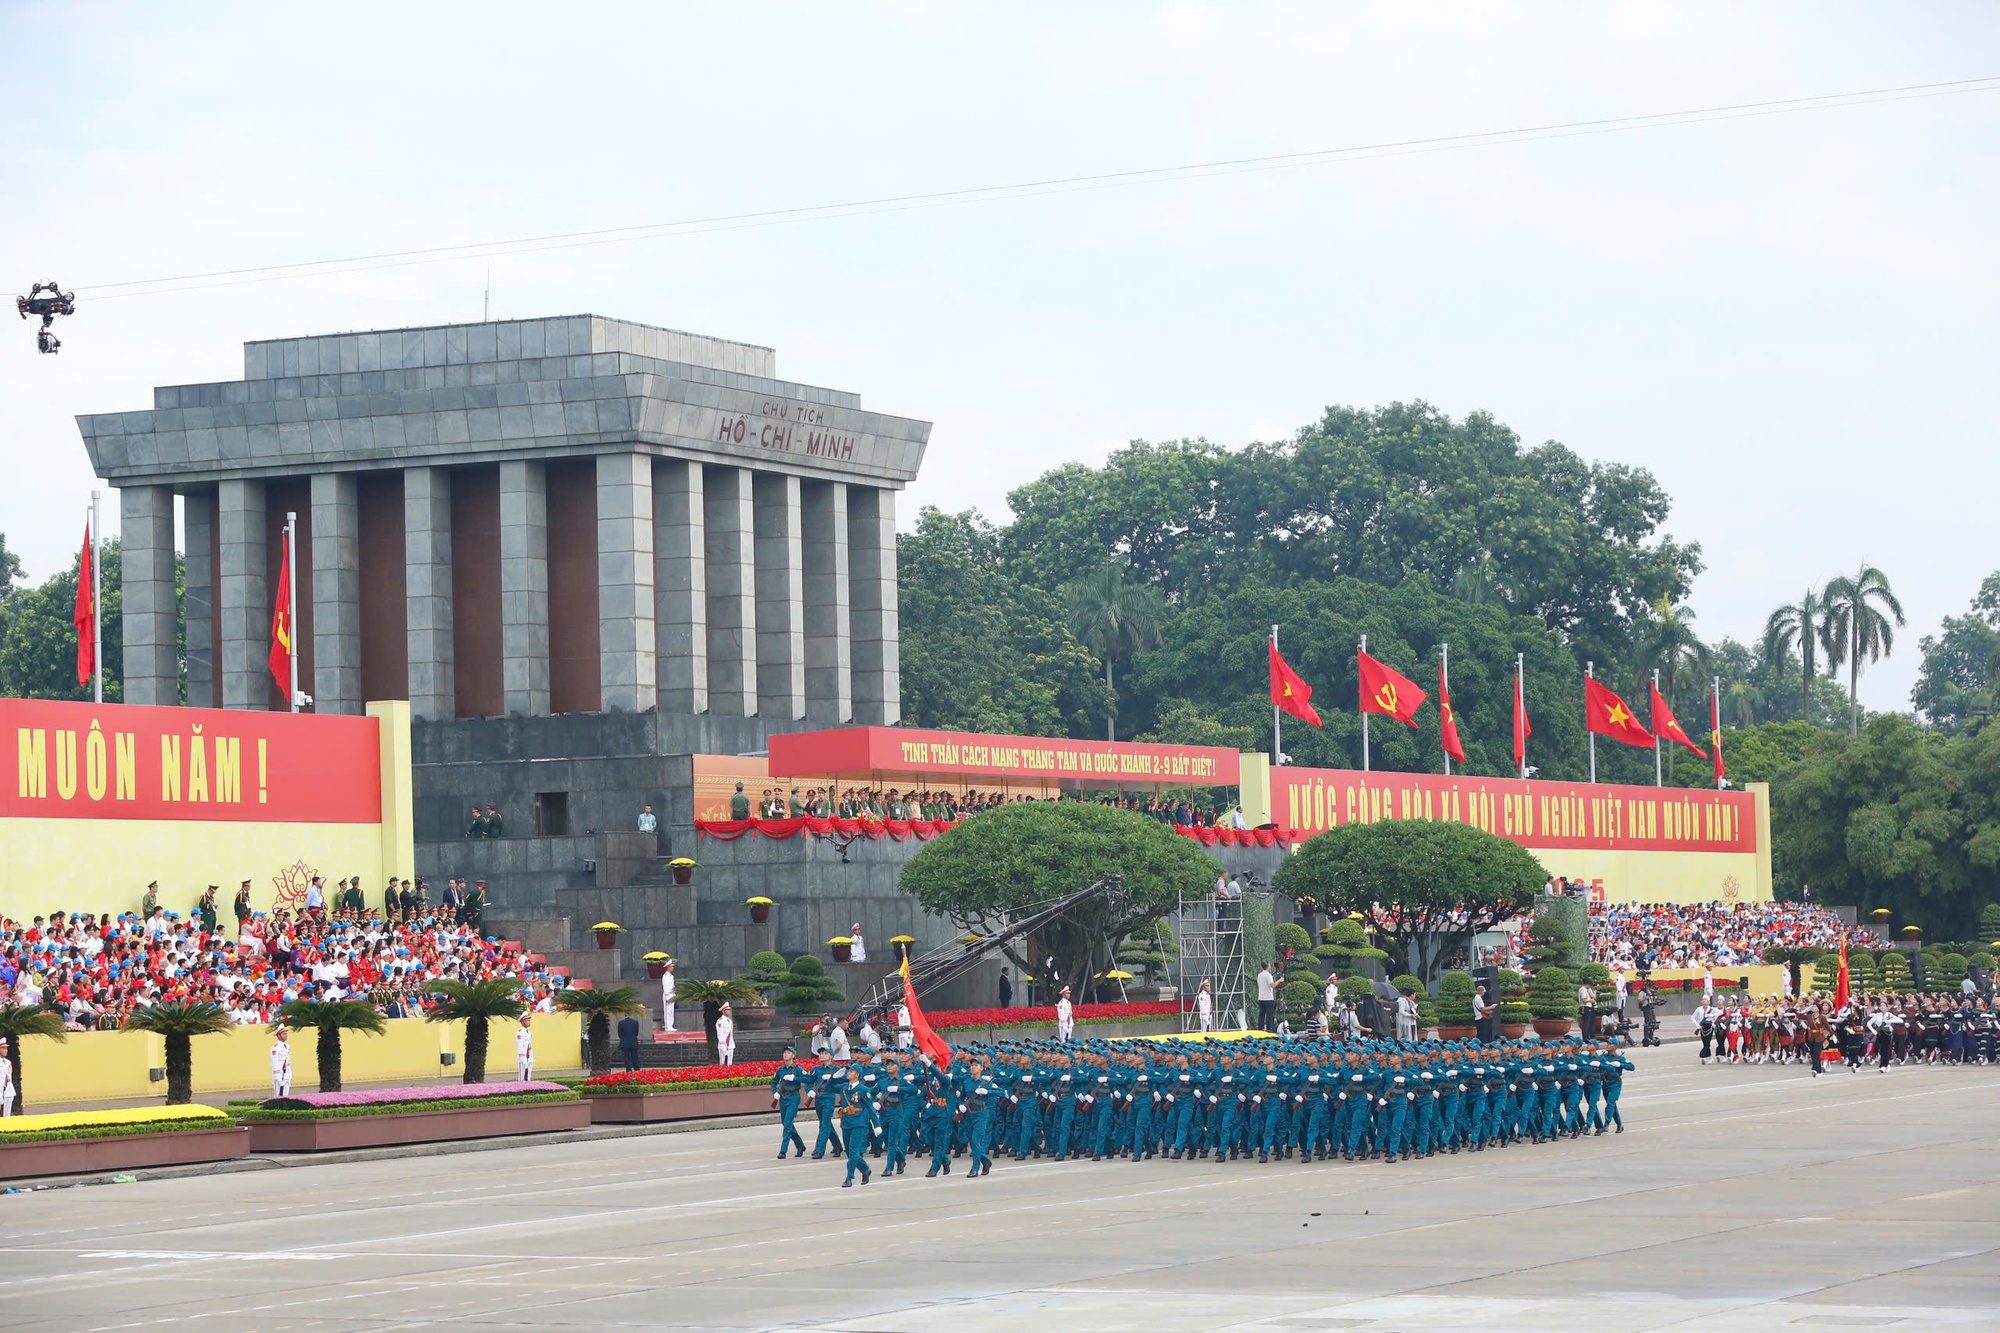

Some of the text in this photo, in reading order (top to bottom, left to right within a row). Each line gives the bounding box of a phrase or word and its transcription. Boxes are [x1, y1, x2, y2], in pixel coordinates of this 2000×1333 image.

[719, 415, 748, 443] HỒ
[760, 422, 795, 451] CHÍ
[807, 427, 855, 460] MINH
[18, 718, 136, 801] MUÔN
[901, 742, 929, 764] TINH
[930, 738, 960, 765] THẦN
[962, 742, 989, 767] CÁCH
[990, 746, 1020, 771] MẠNG
[1021, 746, 1055, 770] THÁNG
[1056, 747, 1078, 771] TÁM
[1079, 748, 1093, 771] VÀ
[1094, 748, 1119, 774] QUỐC
[1120, 751, 1152, 775] KHÁNH
[1153, 755, 1170, 775] 2-9
[1172, 751, 1190, 776] BẤT
[1289, 777, 1337, 831] NƯỚC
[1401, 782, 1433, 823] HÒA
[1441, 784, 1460, 823] XÃ
[1503, 784, 1534, 837] CHỦ
[1541, 790, 1586, 838] NGHĨA
[1592, 791, 1622, 847] VIỆT
[1628, 799, 1658, 840] NAM
[1663, 795, 1700, 841] MUÔN
